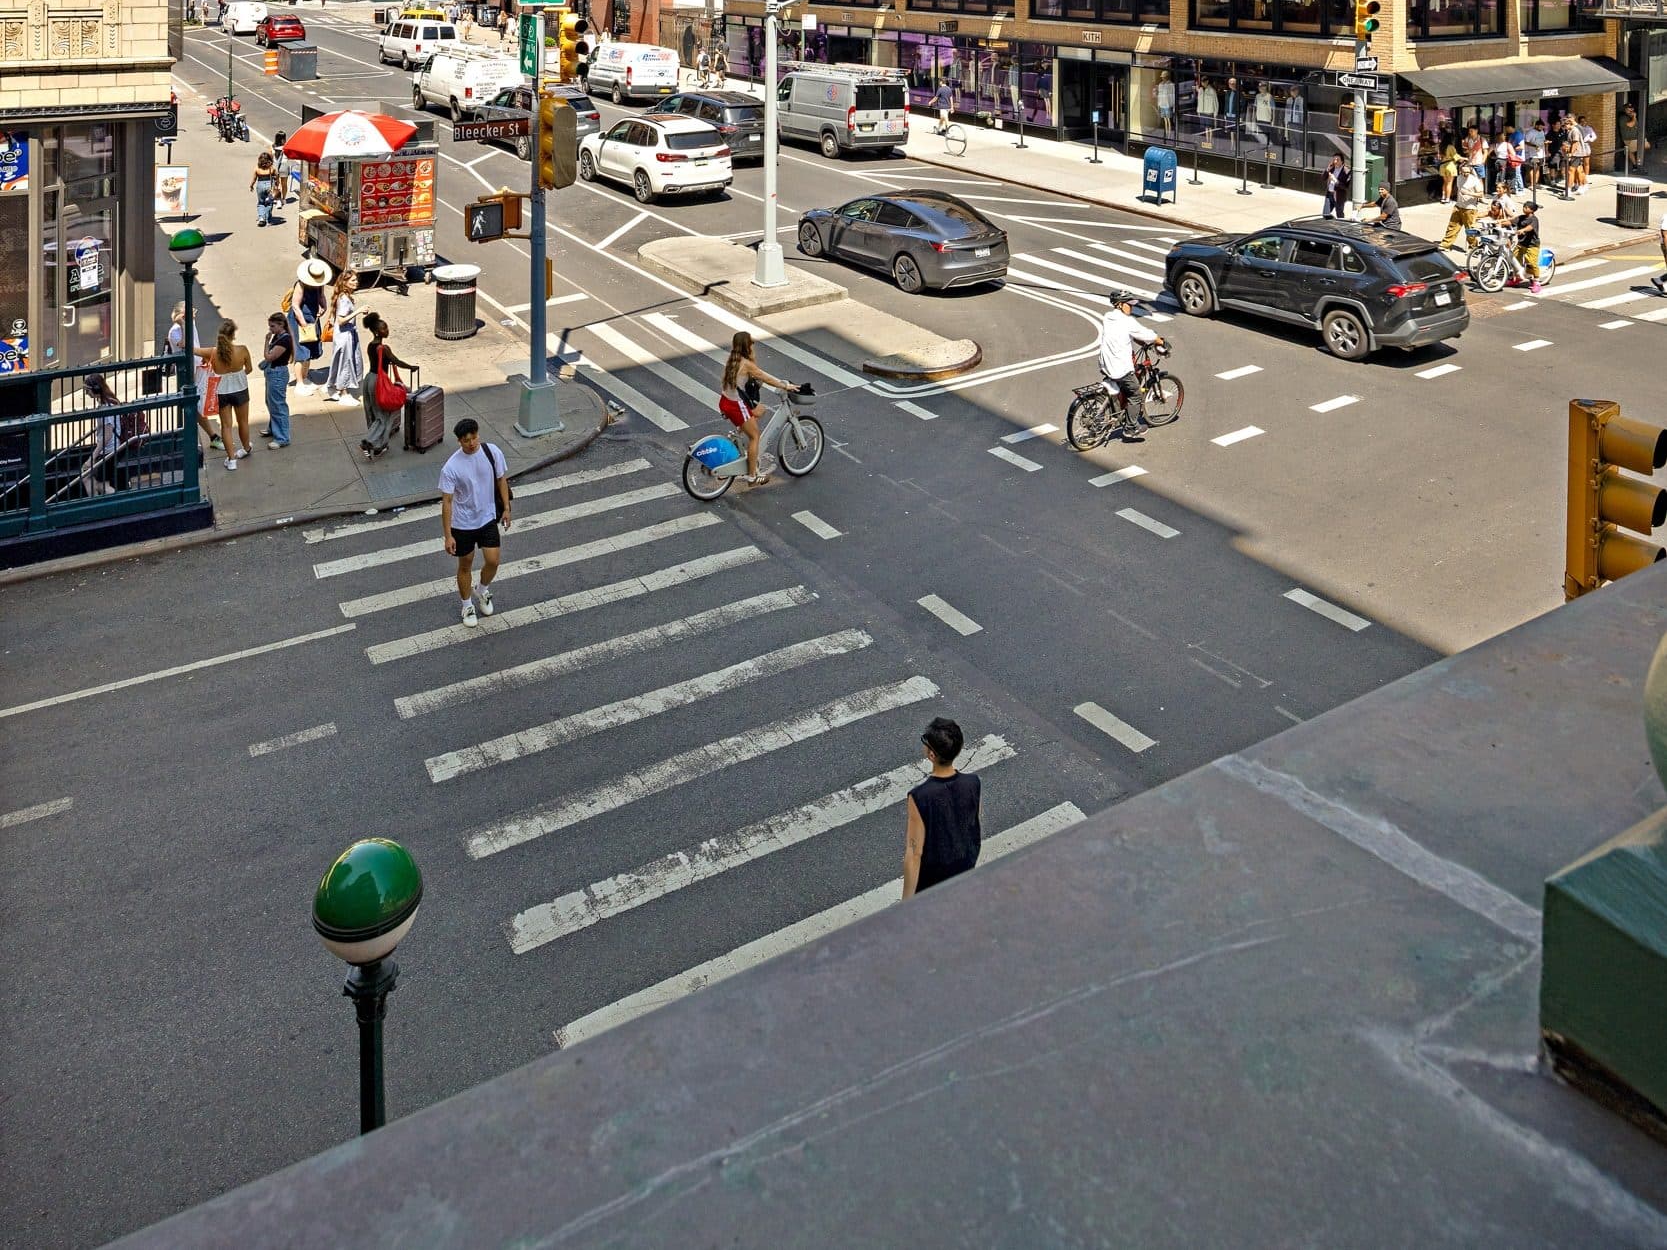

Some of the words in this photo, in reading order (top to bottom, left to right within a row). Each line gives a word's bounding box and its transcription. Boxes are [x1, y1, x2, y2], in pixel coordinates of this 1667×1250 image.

[1083, 33, 1100, 42] KITH
[1342, 76, 1354, 84] ONE
[454, 124, 505, 140] Bleecker
[508, 122, 520, 136] St
